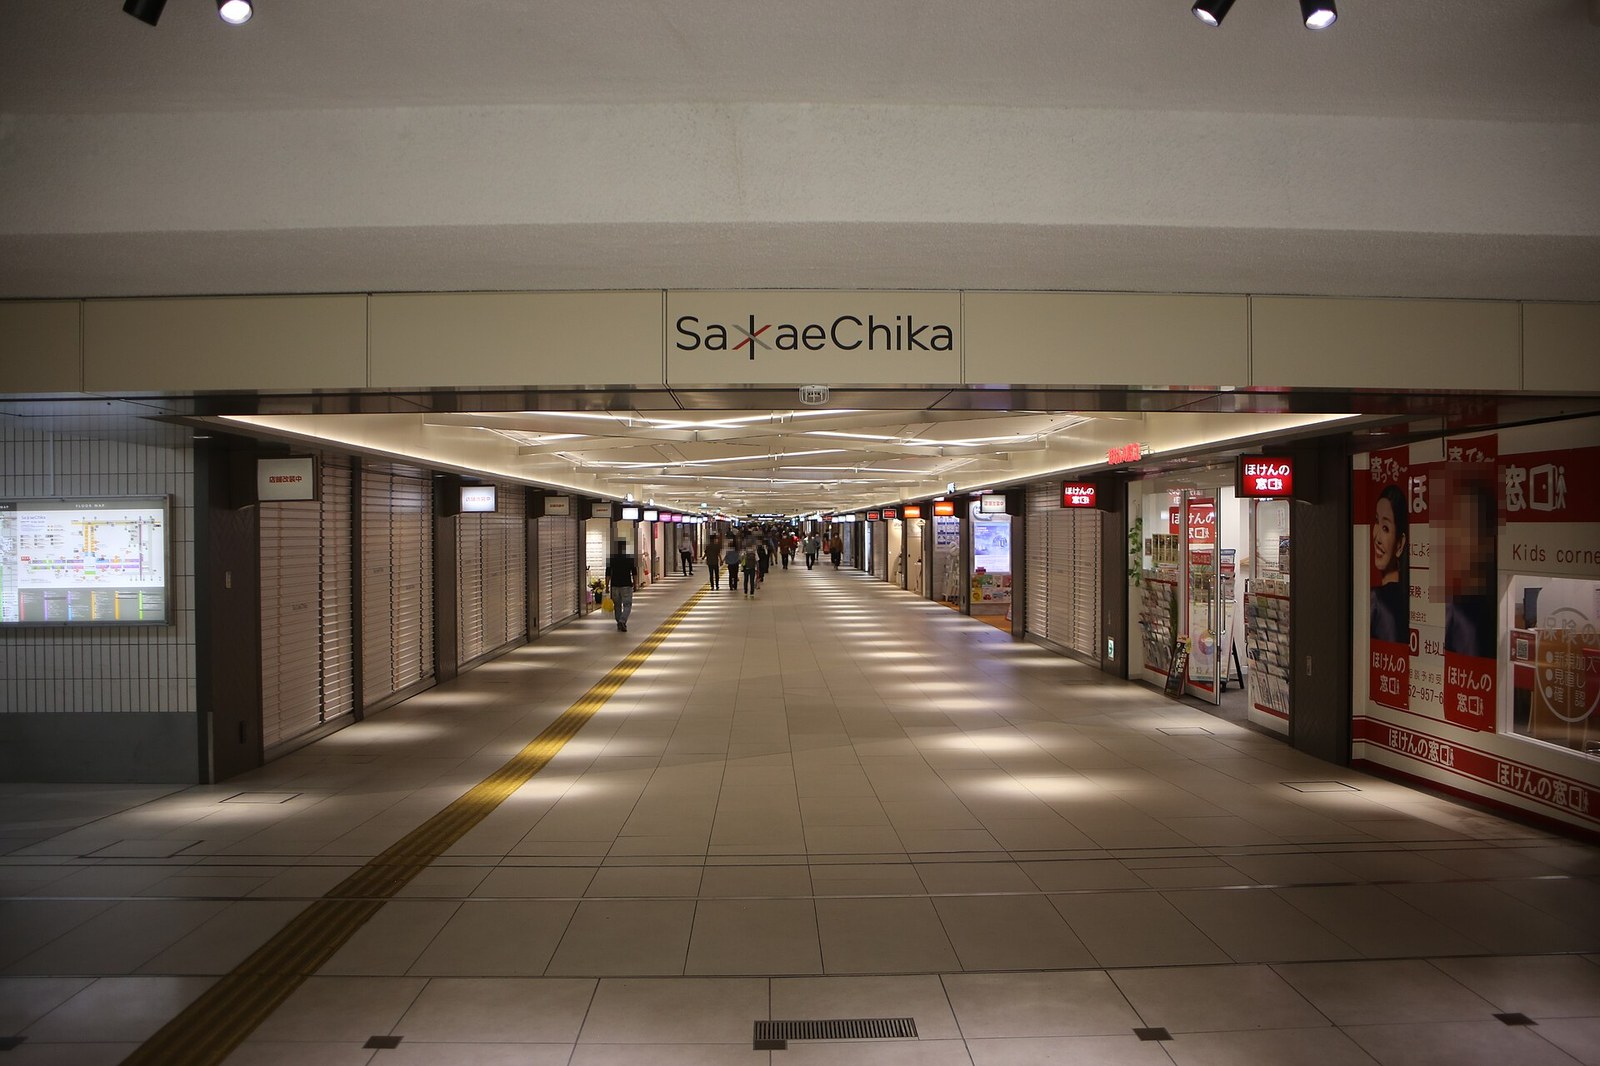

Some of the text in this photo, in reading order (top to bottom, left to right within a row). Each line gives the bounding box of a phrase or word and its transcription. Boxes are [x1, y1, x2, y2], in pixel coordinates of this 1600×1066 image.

[676, 314, 953, 360] SakaeChika
[268, 476, 302, 484] 店舗改装中
[1245, 463, 1290, 476] ほけんの
[1065, 487, 1094, 496] ほけんの
[1512, 544, 1546, 562] Kids
[1372, 651, 1406, 673] ほけんの
[1448, 666, 1492, 692] ほけんの
[1388, 728, 1452, 767] ほけんの窓口
[1497, 762, 1585, 812] ほけんの窓口
